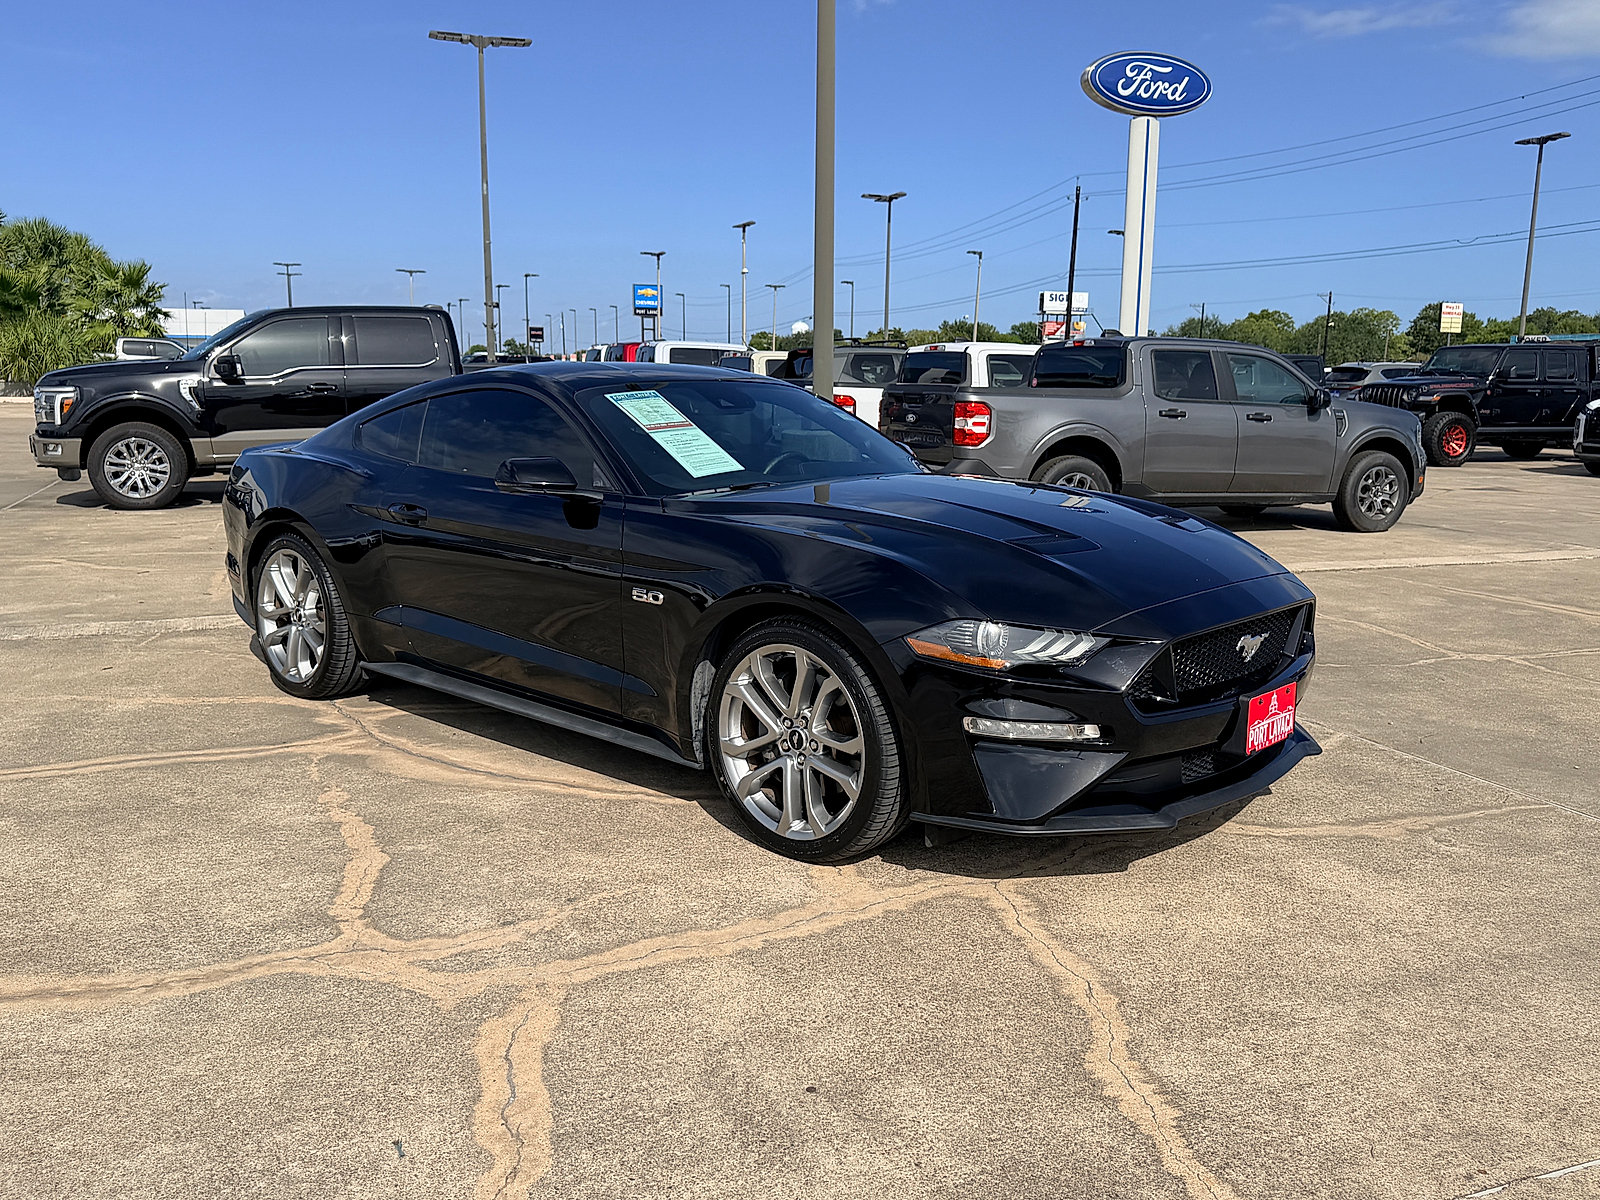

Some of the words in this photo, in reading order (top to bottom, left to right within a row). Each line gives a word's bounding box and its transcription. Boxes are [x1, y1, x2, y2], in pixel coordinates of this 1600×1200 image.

[1117, 61, 1190, 102] Ford
[1248, 724, 1269, 748] PORT
[1270, 713, 1294, 740] LAVACA
